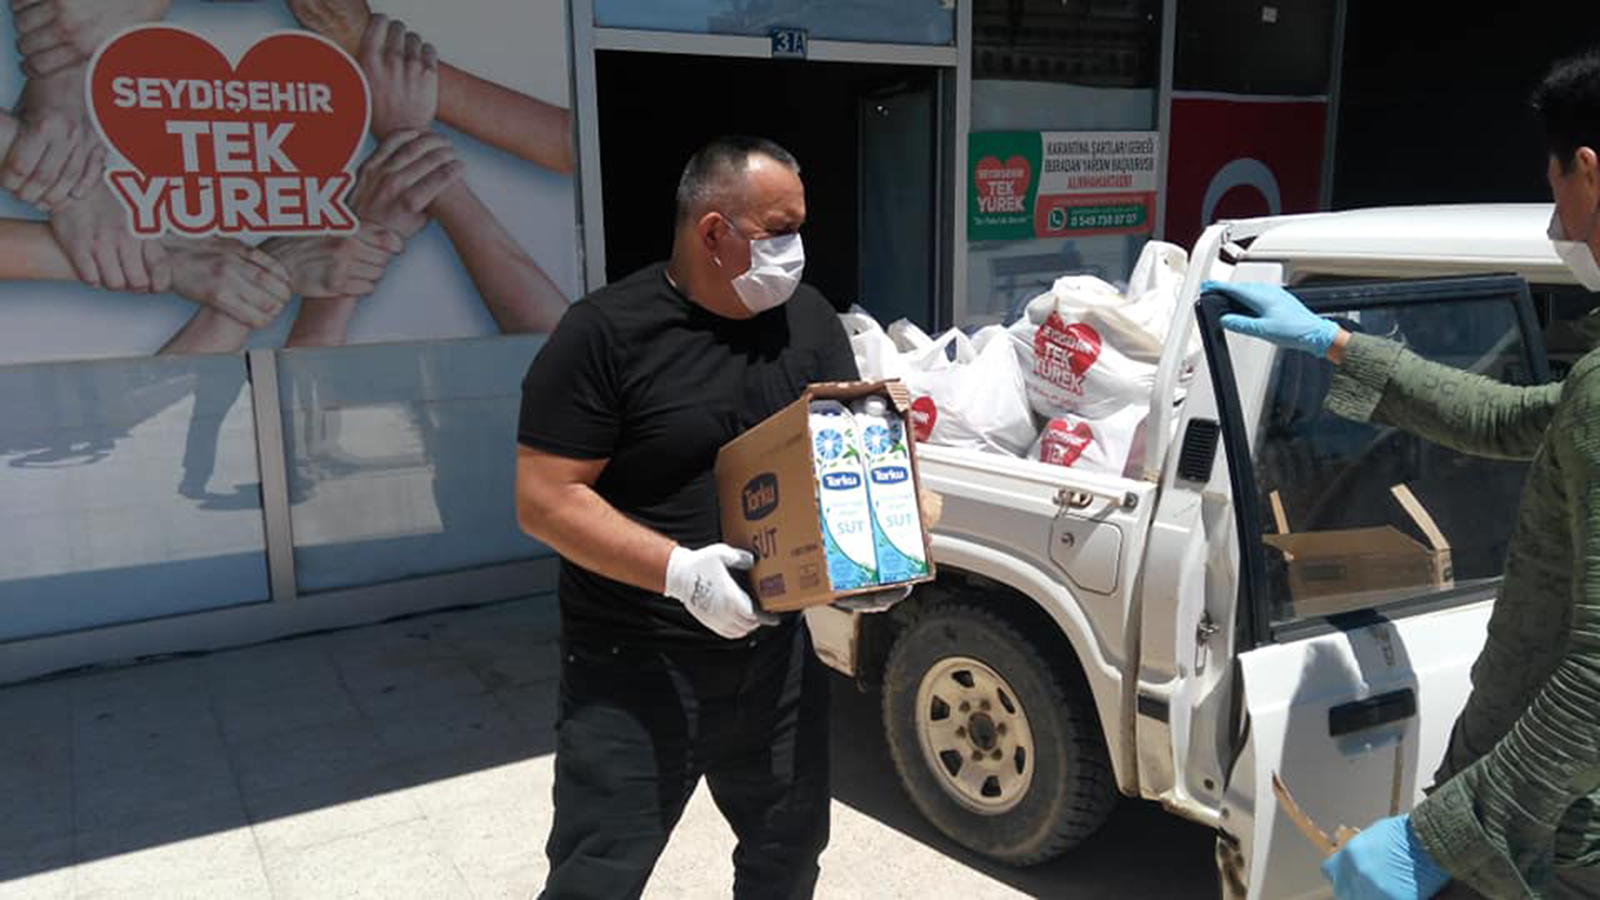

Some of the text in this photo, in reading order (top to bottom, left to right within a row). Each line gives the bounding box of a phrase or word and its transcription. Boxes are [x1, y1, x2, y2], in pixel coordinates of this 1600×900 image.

[165, 120, 300, 173] TEK
[986, 181, 1014, 196] TEK
[119, 175, 351, 230] YÜREK
[1044, 342, 1073, 368] TEK
[826, 475, 858, 487] Torku
[874, 468, 906, 481] Torku
[745, 483, 774, 511] Torku
